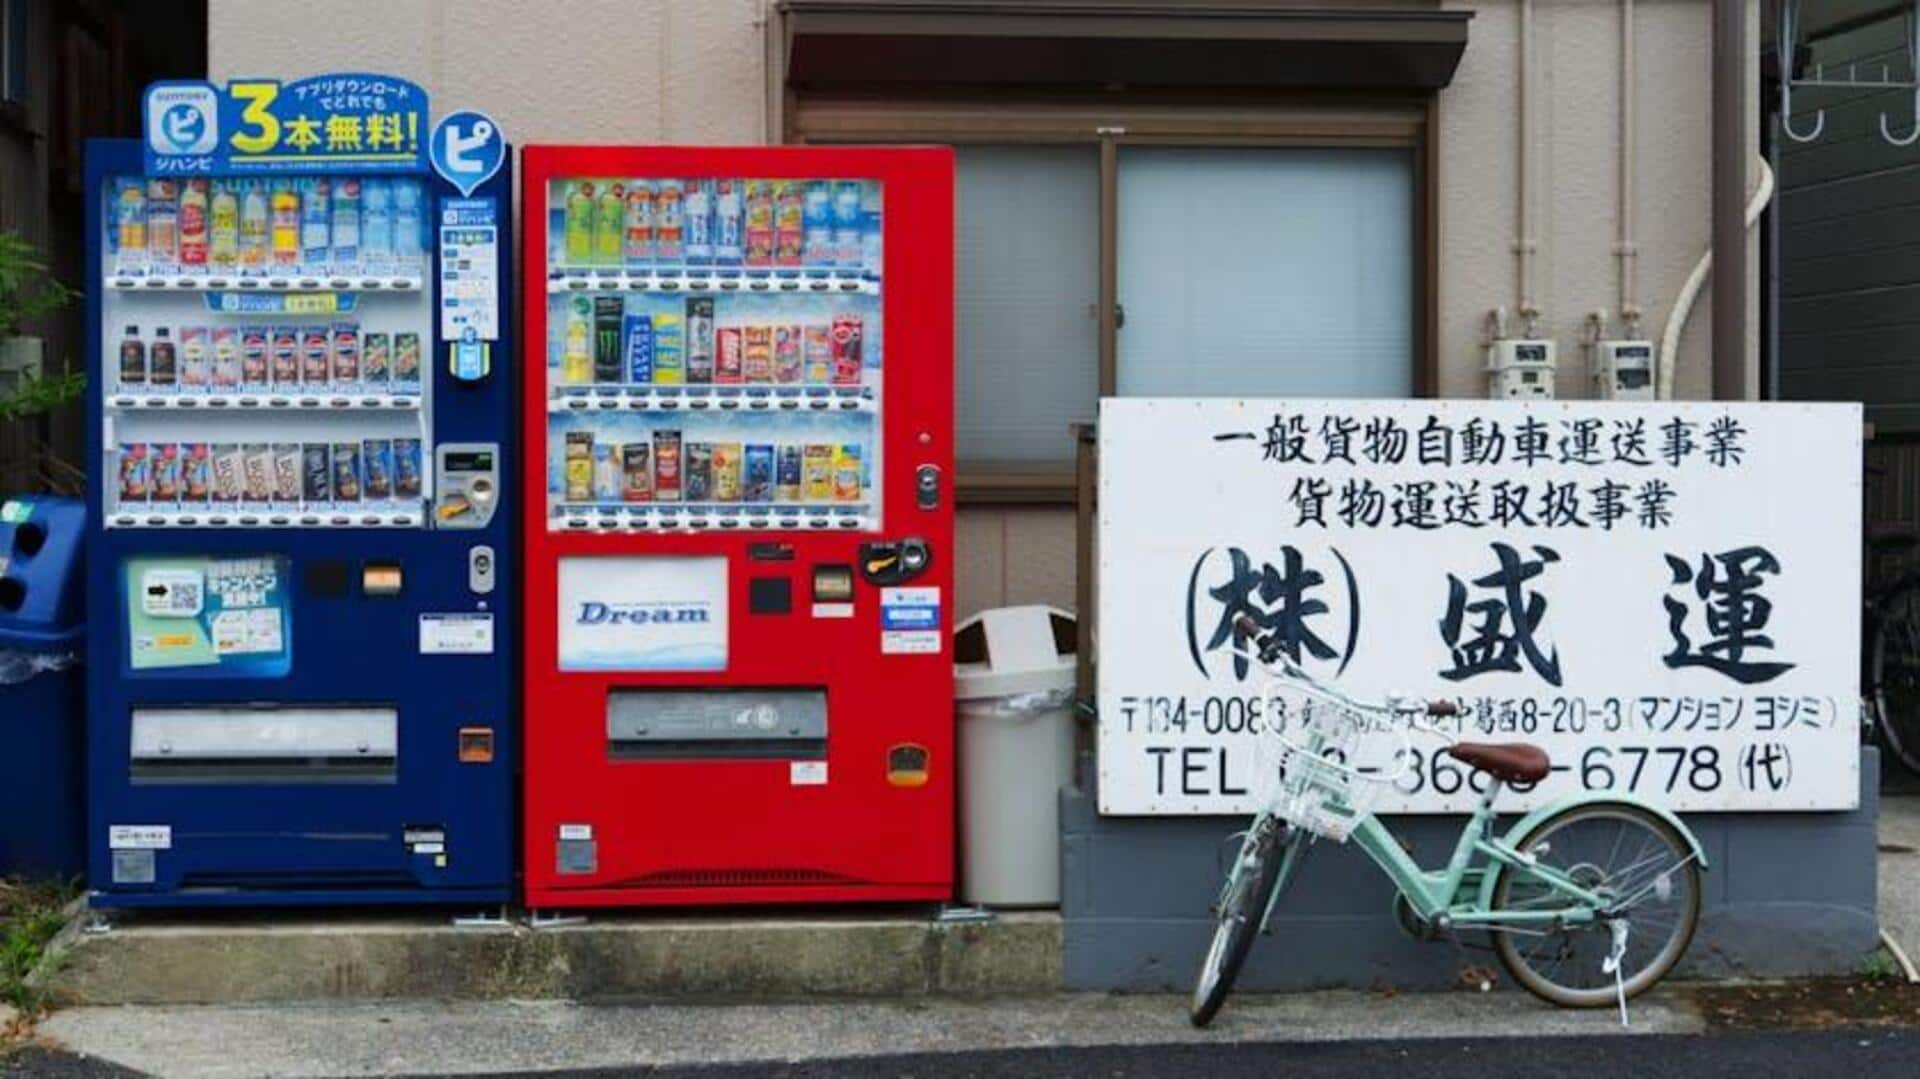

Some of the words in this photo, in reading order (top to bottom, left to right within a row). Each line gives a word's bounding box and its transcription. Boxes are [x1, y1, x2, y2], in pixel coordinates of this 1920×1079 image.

[294, 79, 409, 99] アプリダウンロード
[169, 109, 199, 142] ピ
[229, 82, 419, 153] 3本無料!
[445, 120, 493, 172] ピ
[1213, 414, 1746, 467] 一般貨物自動車運送事業
[1288, 477, 1676, 530] 貨物運送取扱事業
[576, 601, 711, 625] Dream
[1145, 747, 1248, 795] TEL
[1738, 743, 1793, 792] (代)
